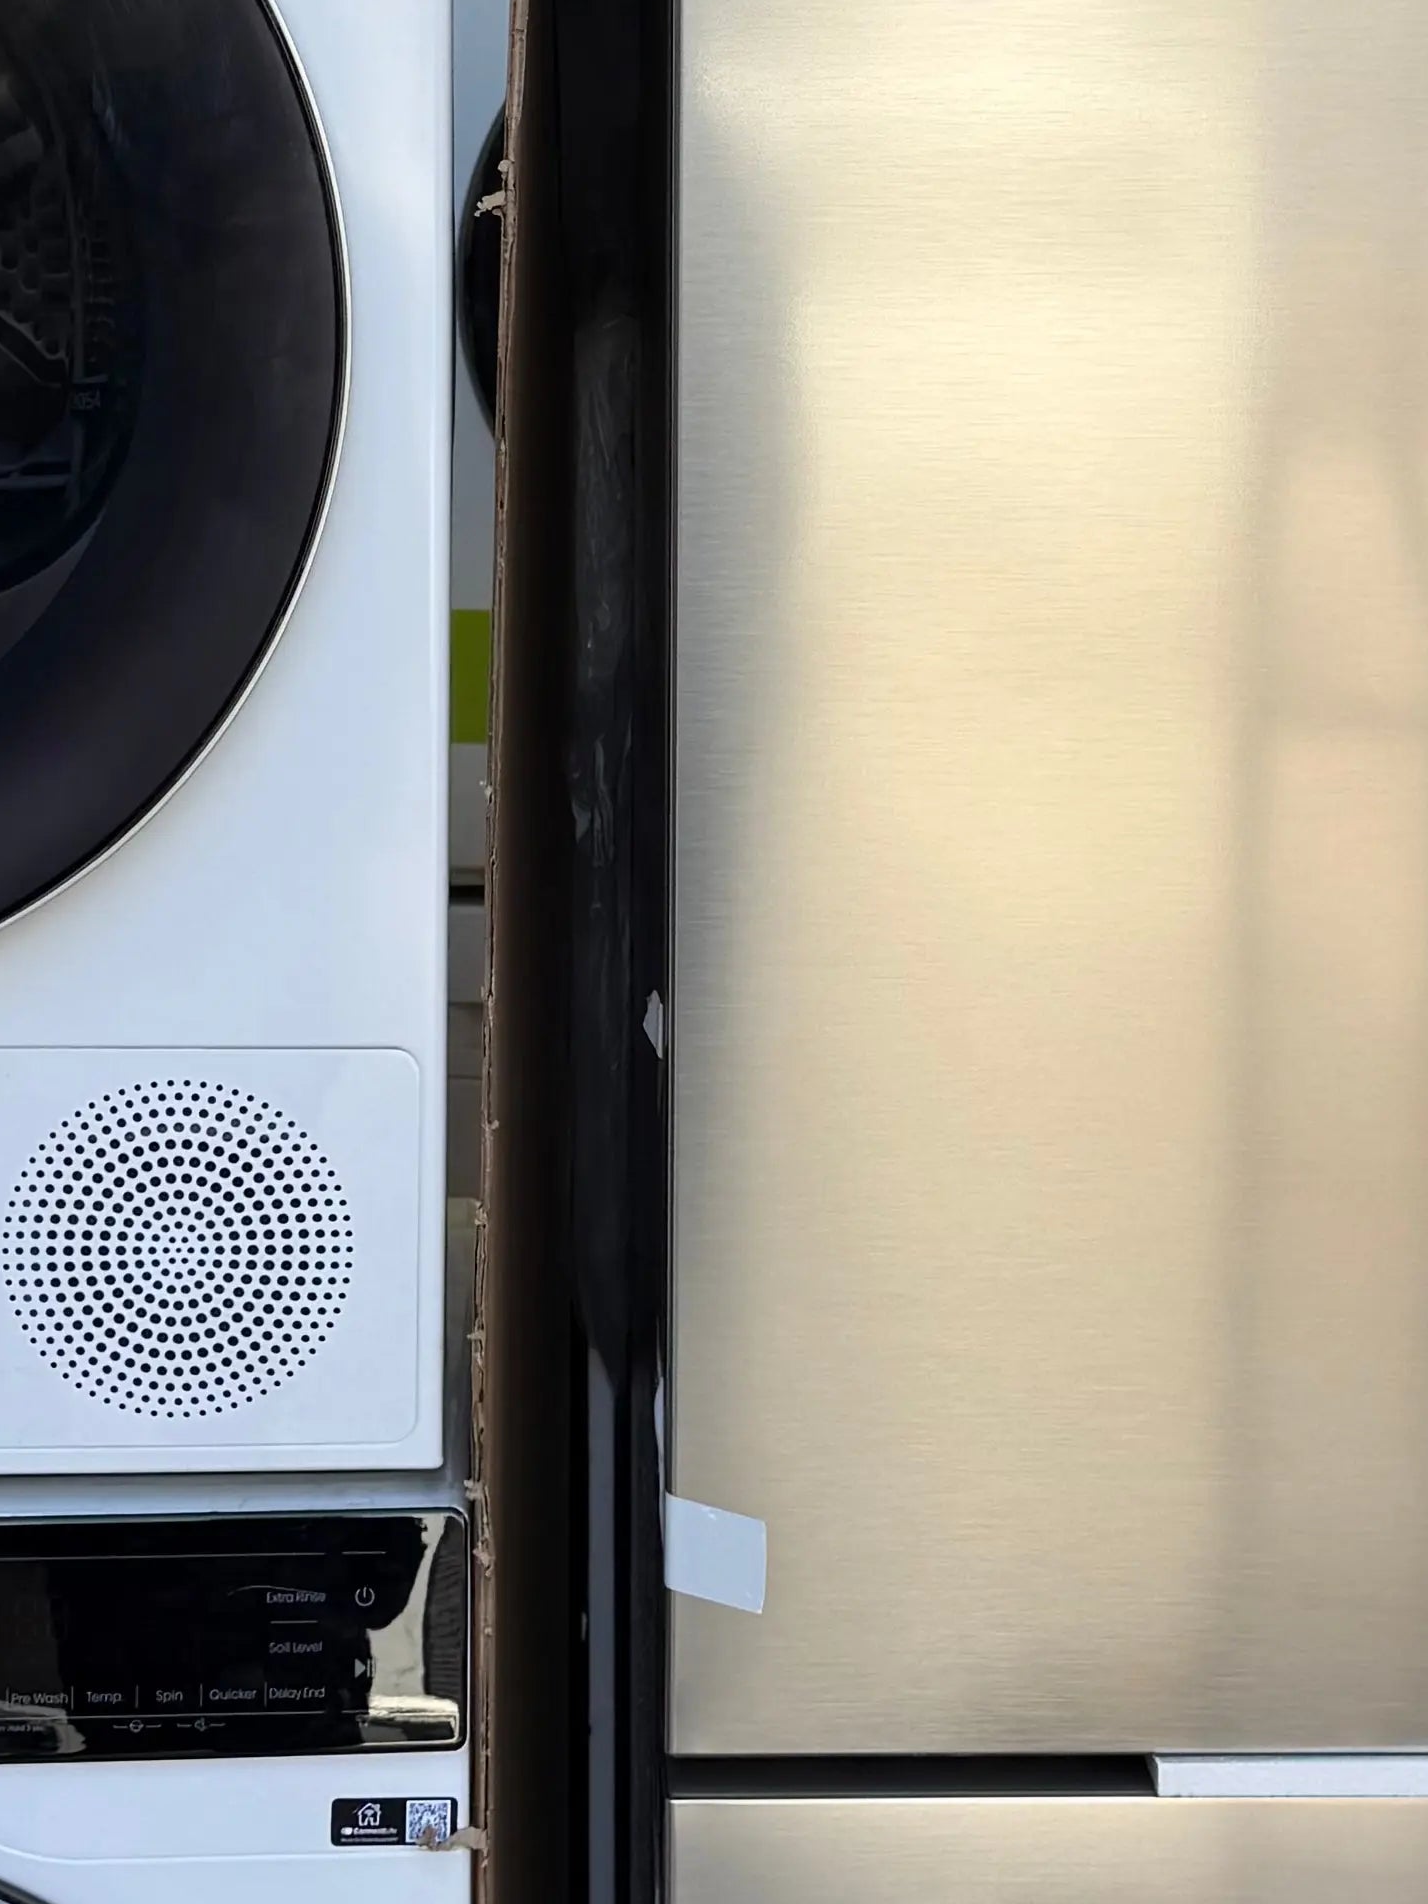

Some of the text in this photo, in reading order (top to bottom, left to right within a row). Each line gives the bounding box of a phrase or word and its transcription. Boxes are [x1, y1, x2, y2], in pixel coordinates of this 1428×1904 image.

[293, 1642, 323, 1653] Level
[11, 1693, 68, 1704] Pre Wash
[156, 1690, 183, 1703] Spin
[209, 1689, 257, 1700] Quicker
[269, 1687, 326, 1701] Delay End
